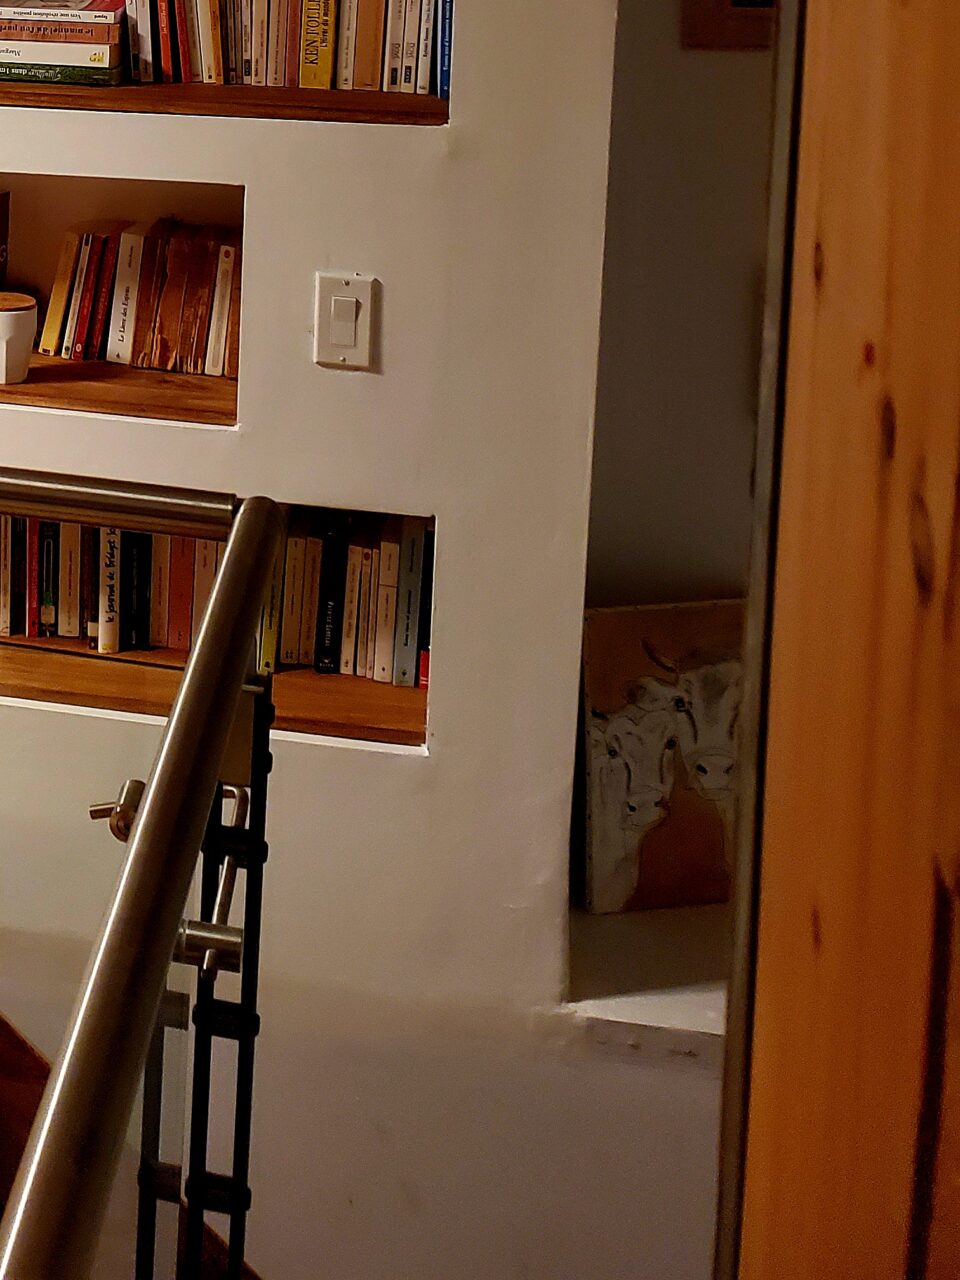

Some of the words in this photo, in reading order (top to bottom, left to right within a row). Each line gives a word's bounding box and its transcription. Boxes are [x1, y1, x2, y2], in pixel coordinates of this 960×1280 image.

[304, 38, 320, 66] KEN
[11, 68, 27, 77] dans
[118, 318, 127, 333] Livre
[117, 334, 125, 342] Le
[104, 539, 117, 568] Bridget
[106, 571, 115, 581] de
[105, 584, 117, 613] journal
